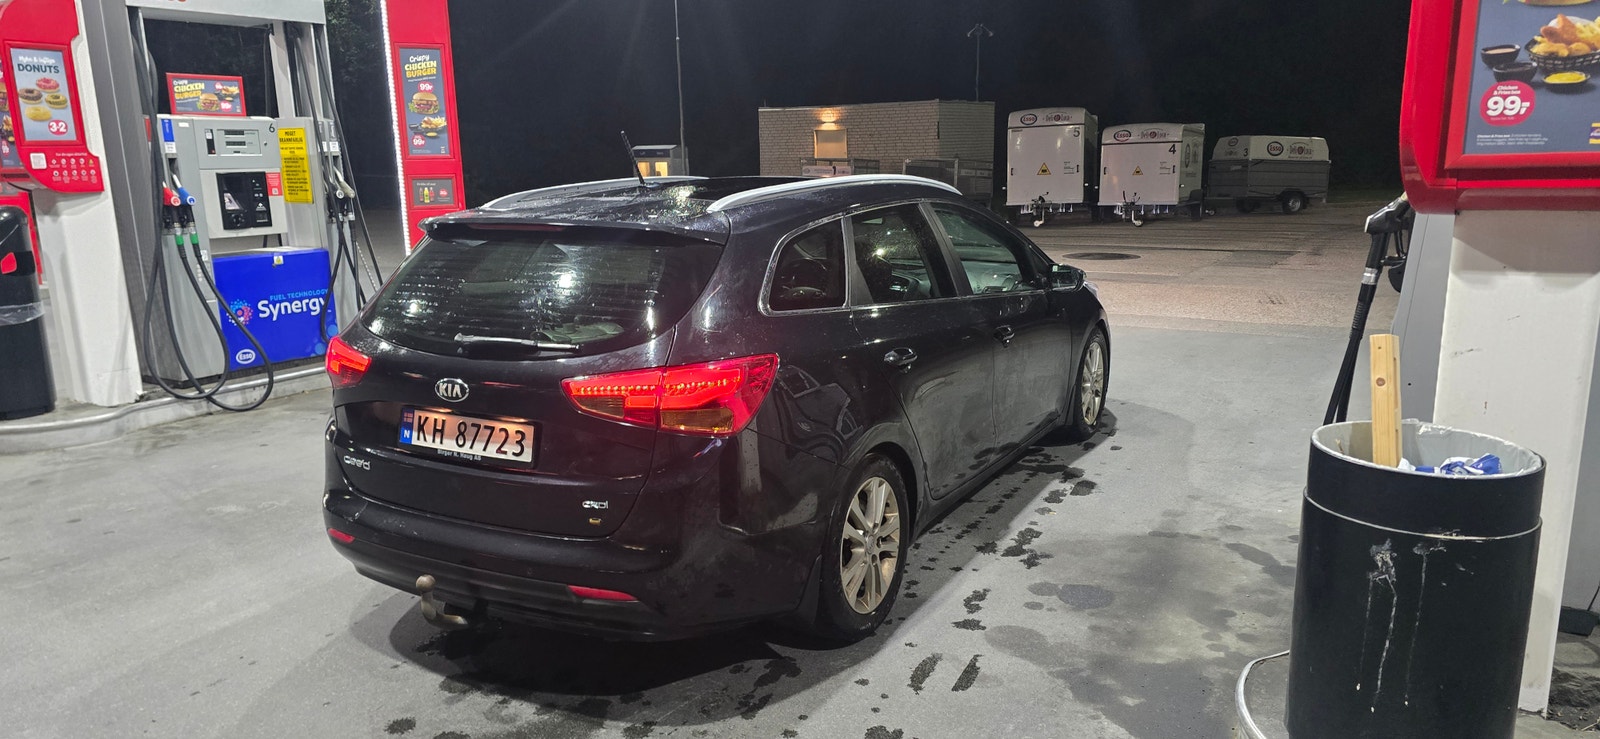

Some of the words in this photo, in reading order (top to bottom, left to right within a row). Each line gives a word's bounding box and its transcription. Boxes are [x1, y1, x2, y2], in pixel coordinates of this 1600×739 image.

[409, 54, 430, 63] Crispy
[17, 63, 60, 74] DONUTS
[404, 60, 437, 71] CHICKEN
[406, 67, 437, 78] BURGER
[174, 82, 205, 92] CHICKEN
[268, 123, 275, 133] 6
[1073, 127, 1080, 138] 5
[1168, 143, 1176, 154] 4
[1243, 147, 1249, 157] 3
[286, 288, 329, 300] TECHNOLOGY
[439, 382, 463, 398] KIA
[403, 430, 410, 438] N
[416, 415, 446, 445] KH
[455, 421, 526, 457] 87723
